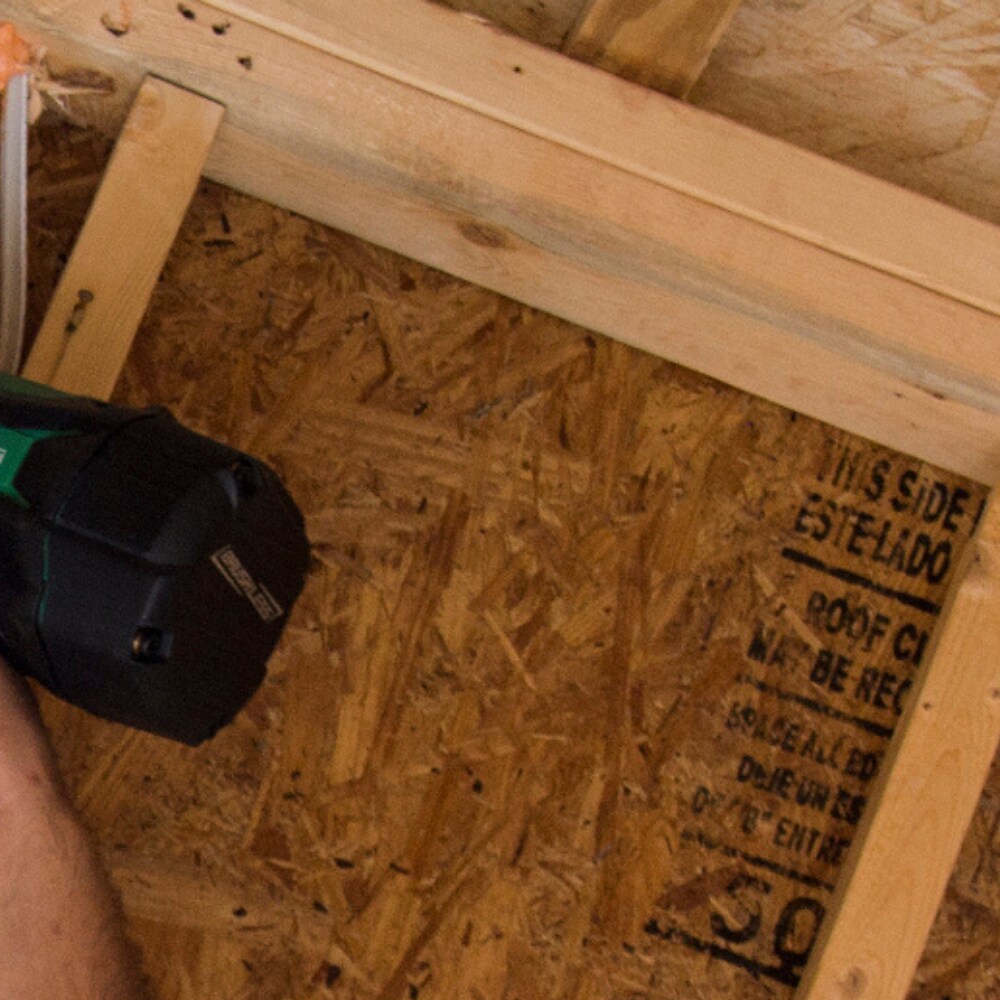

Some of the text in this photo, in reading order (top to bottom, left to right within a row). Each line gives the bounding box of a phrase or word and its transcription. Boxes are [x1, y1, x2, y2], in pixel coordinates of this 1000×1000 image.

[891, 470, 970, 532] SIDE
[872, 520, 953, 584] LADO
[809, 650, 853, 693] BE
